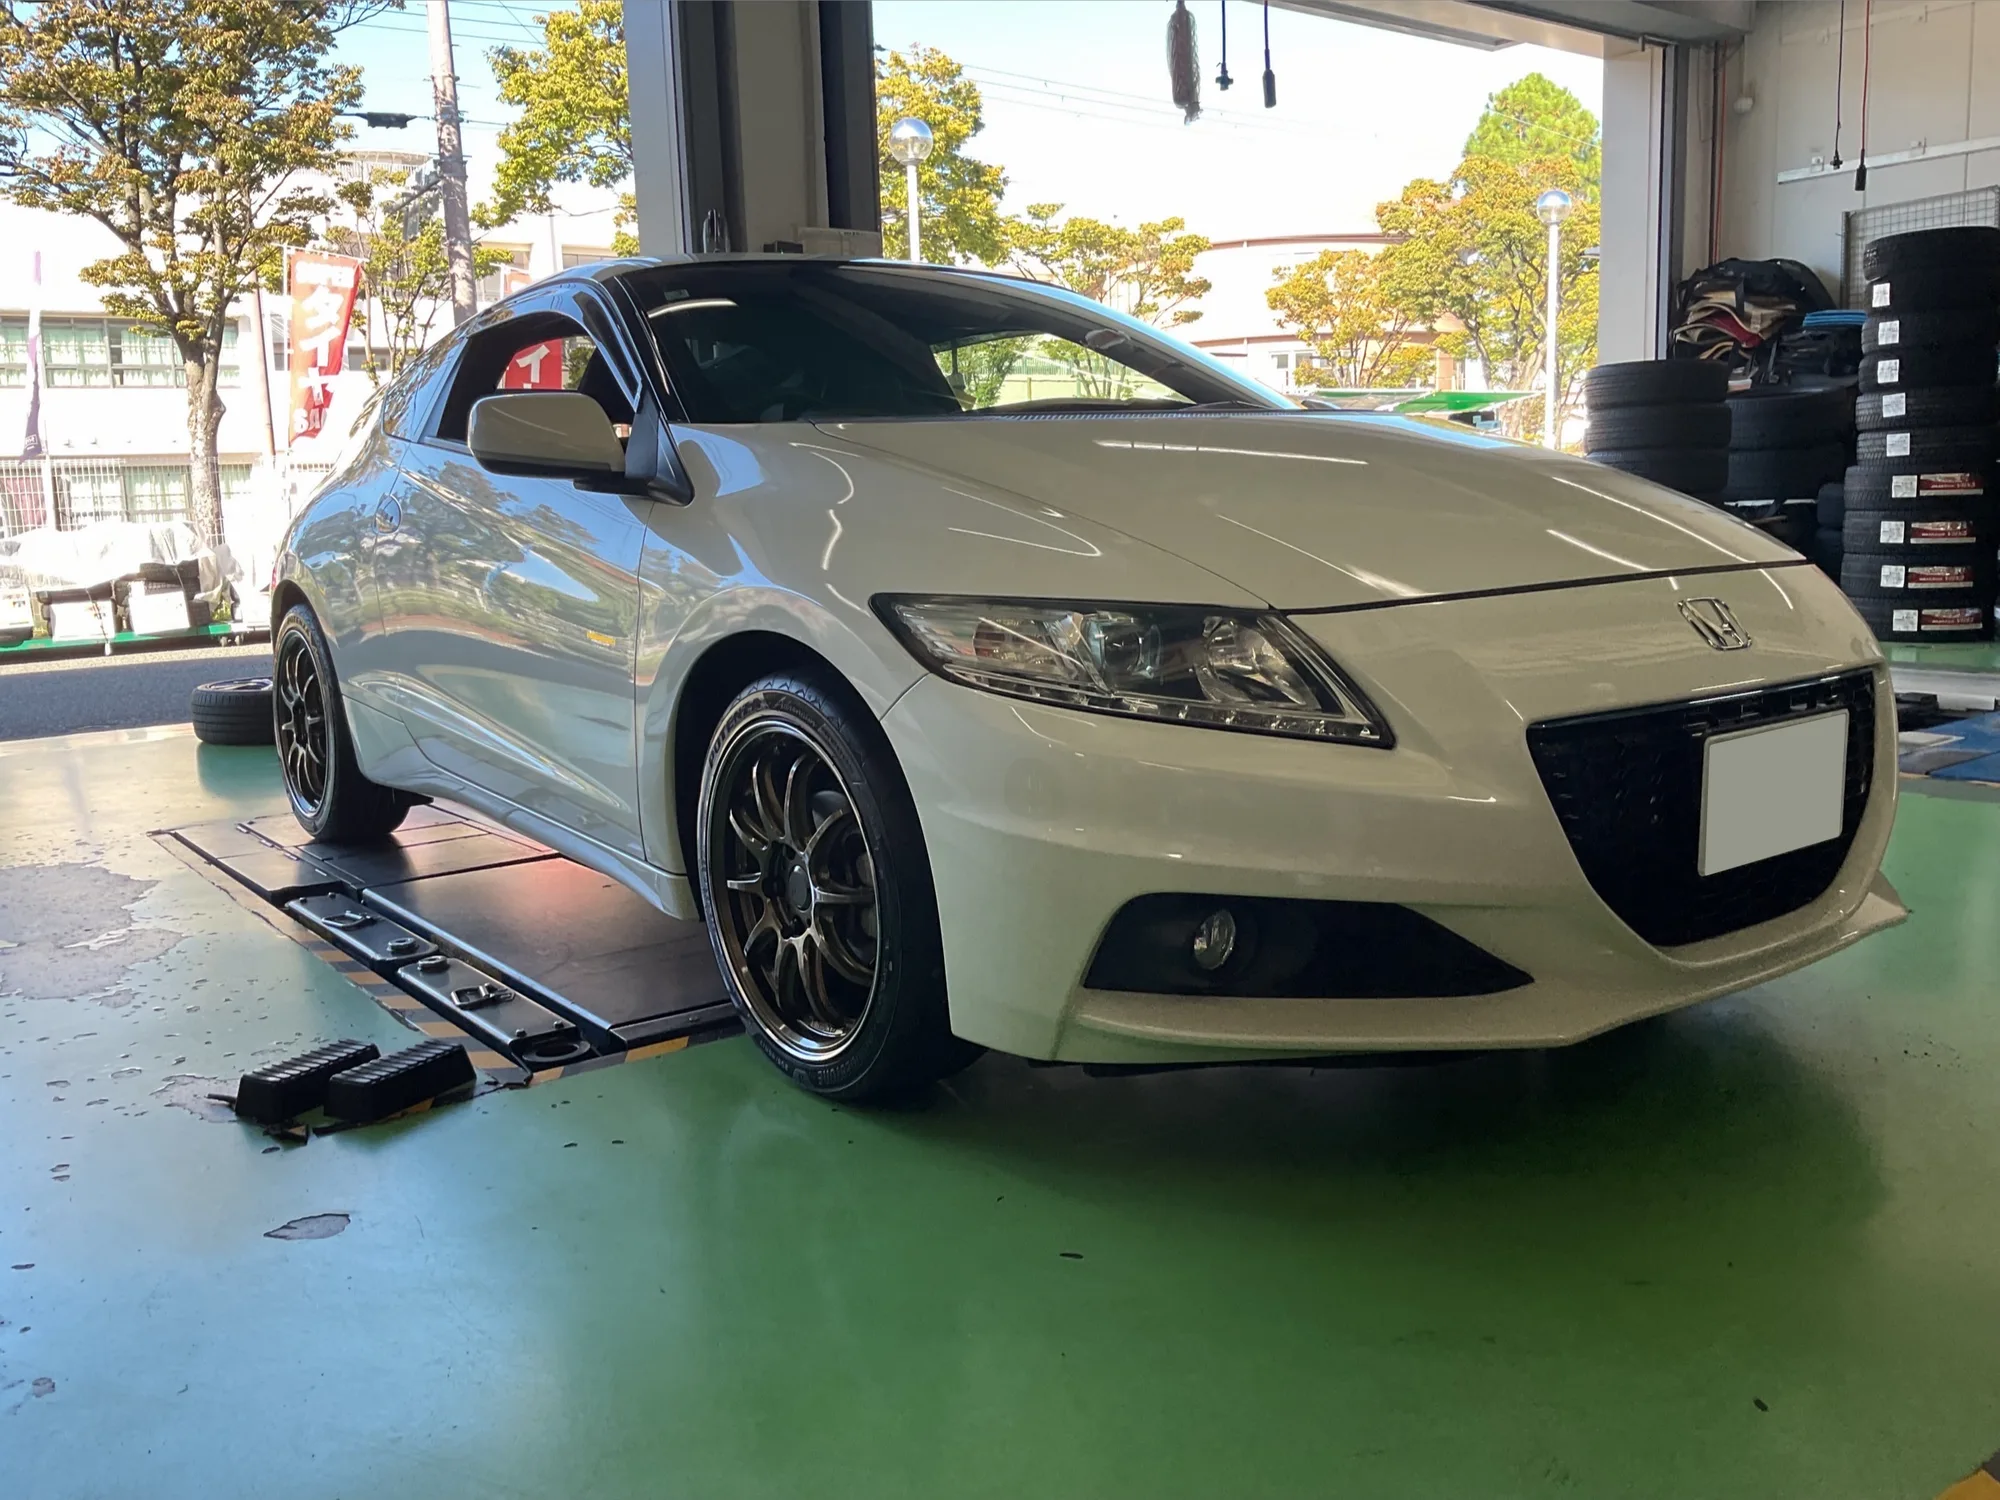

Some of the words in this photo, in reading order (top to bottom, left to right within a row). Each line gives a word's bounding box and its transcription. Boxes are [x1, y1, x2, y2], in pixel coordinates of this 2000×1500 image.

[299, 285, 343, 405] タイヤ
[516, 344, 550, 389] イ
